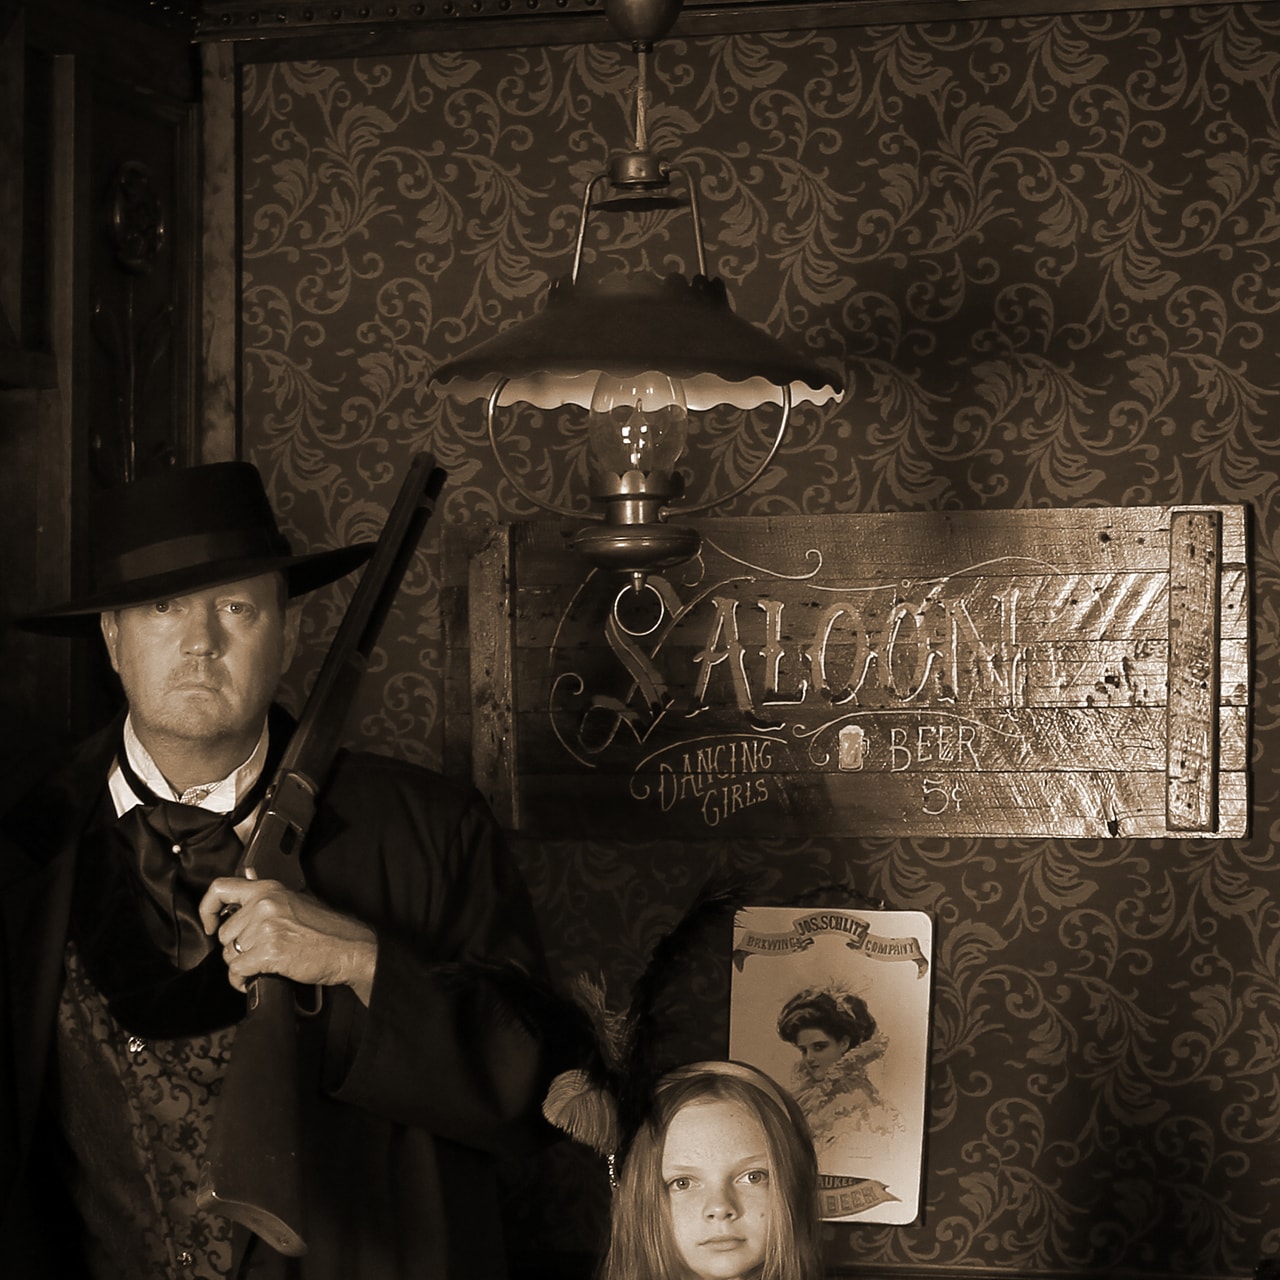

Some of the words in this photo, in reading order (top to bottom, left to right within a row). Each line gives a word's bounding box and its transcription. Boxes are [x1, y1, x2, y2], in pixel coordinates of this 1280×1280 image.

[577, 575, 1028, 753] SALOON
[889, 726, 981, 772] BEER
[658, 741, 773, 812] DANCING
[921, 778, 964, 815] 5¢
[701, 781, 770, 828] GIRLS
[864, 939, 917, 956] COMPANY
